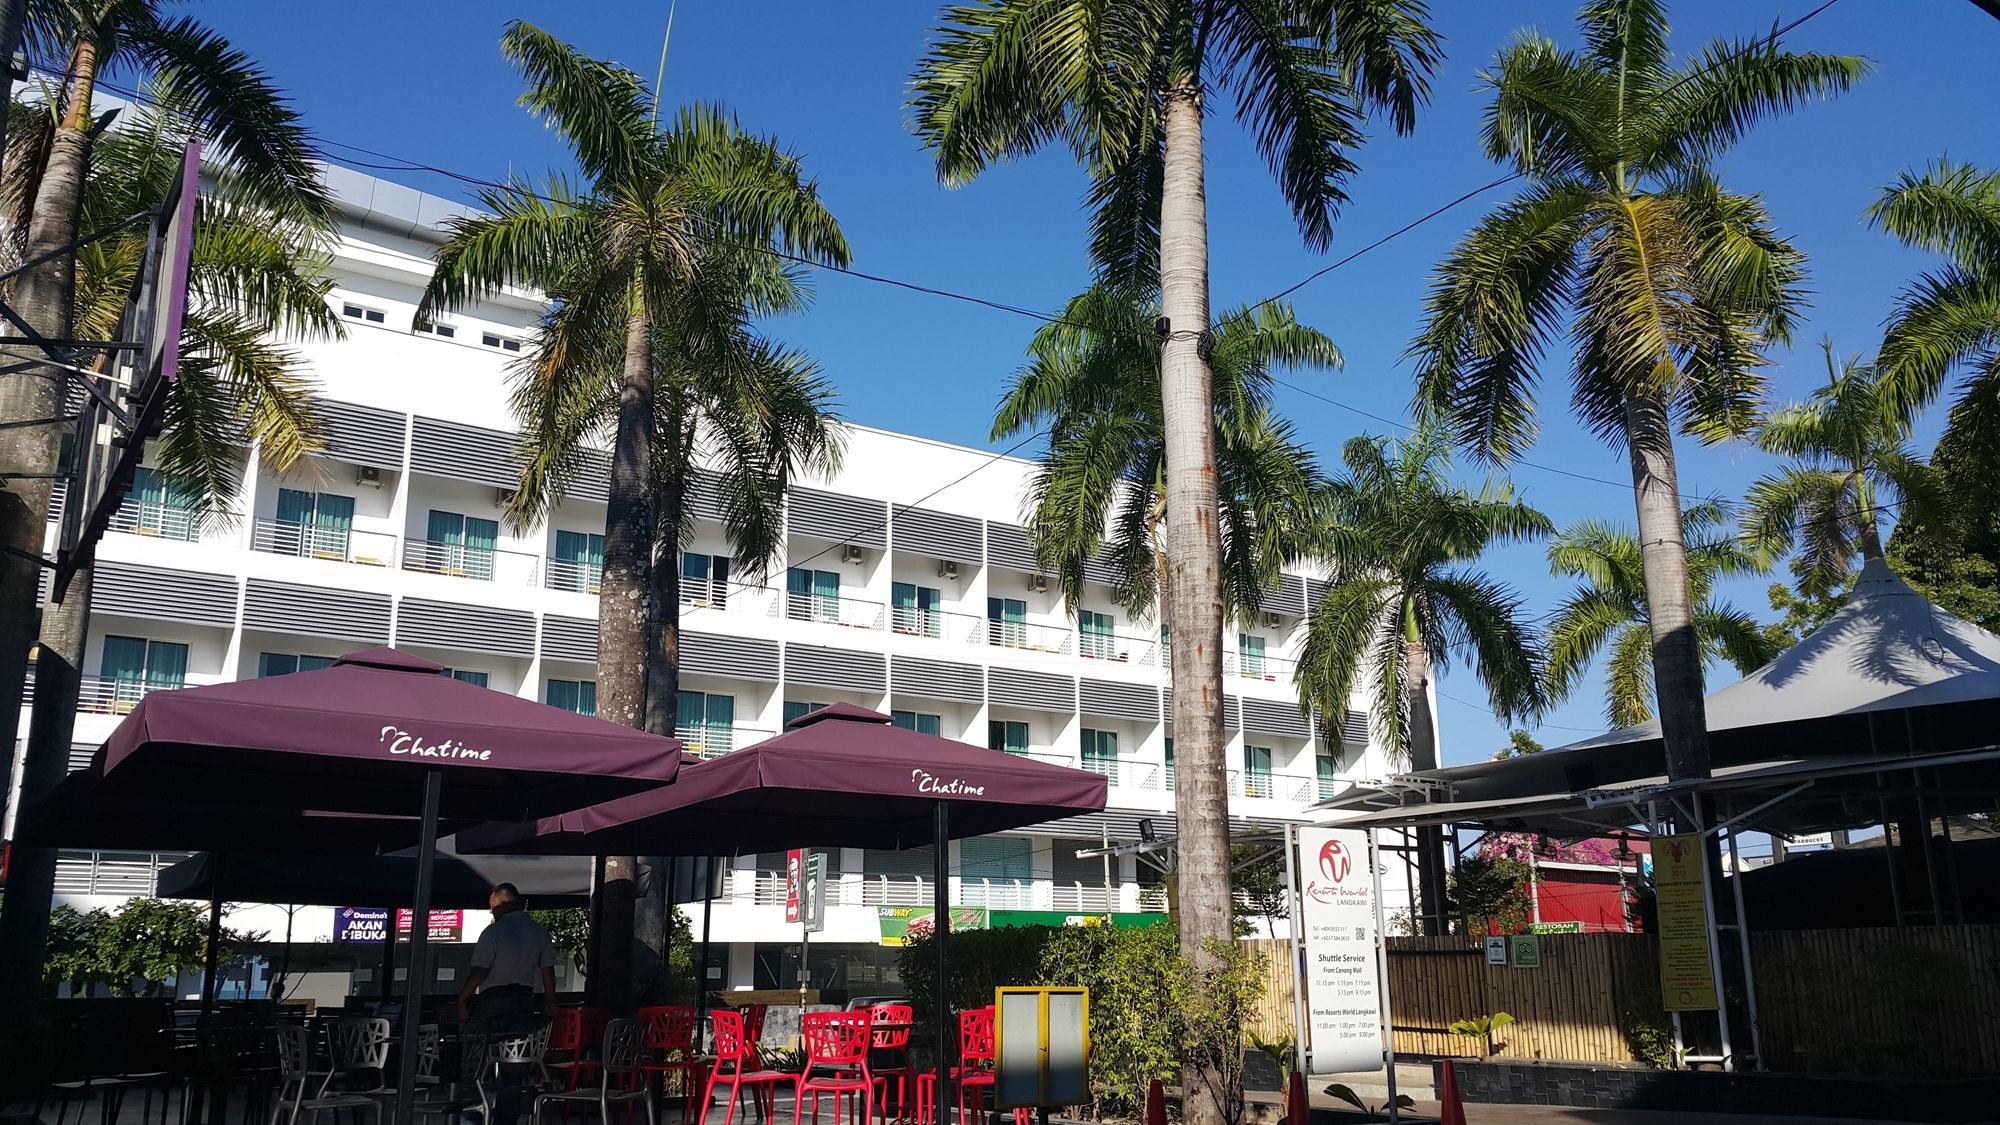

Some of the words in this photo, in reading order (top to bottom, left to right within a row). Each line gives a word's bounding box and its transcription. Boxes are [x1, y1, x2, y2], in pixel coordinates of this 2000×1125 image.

[390, 737, 491, 760] Chatime
[919, 777, 984, 796] Chatime
[1306, 881, 1338, 899] Resorts
[1340, 886, 1368, 896] World
[880, 908, 911, 916] SUBWAY
[348, 921, 383, 930] AKAN
[341, 930, 387, 940] DIBUKA
[1318, 954, 1342, 962] Shuttle
[1343, 954, 1365, 962] Service
[1335, 967, 1352, 975] Cenang
[1355, 1008, 1376, 1016] Langkawi
